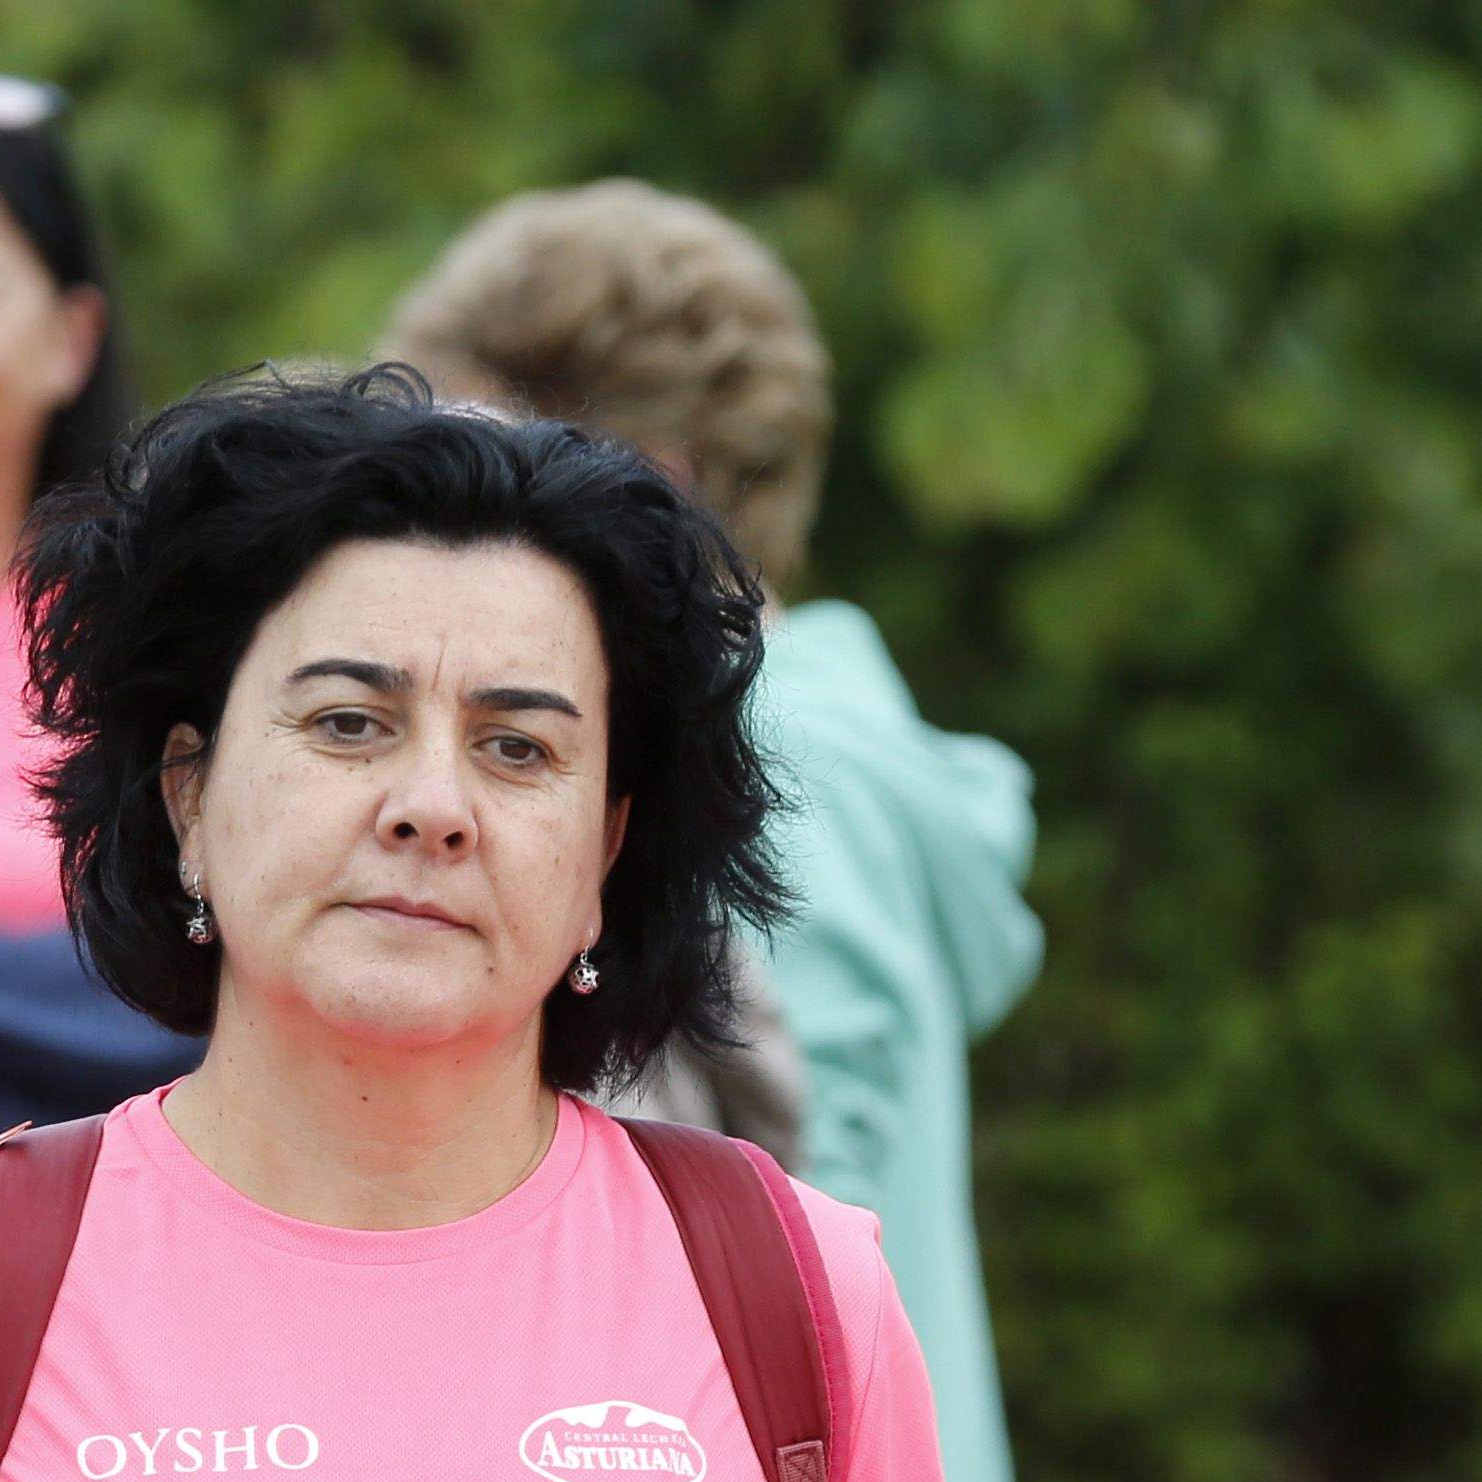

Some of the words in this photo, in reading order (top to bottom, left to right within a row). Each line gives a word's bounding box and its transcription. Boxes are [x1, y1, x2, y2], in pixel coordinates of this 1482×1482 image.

[76, 1423, 319, 1480] OYSHO
[537, 1430, 697, 1476] ASTURIANA
[564, 1430, 629, 1444] CENTRAL
